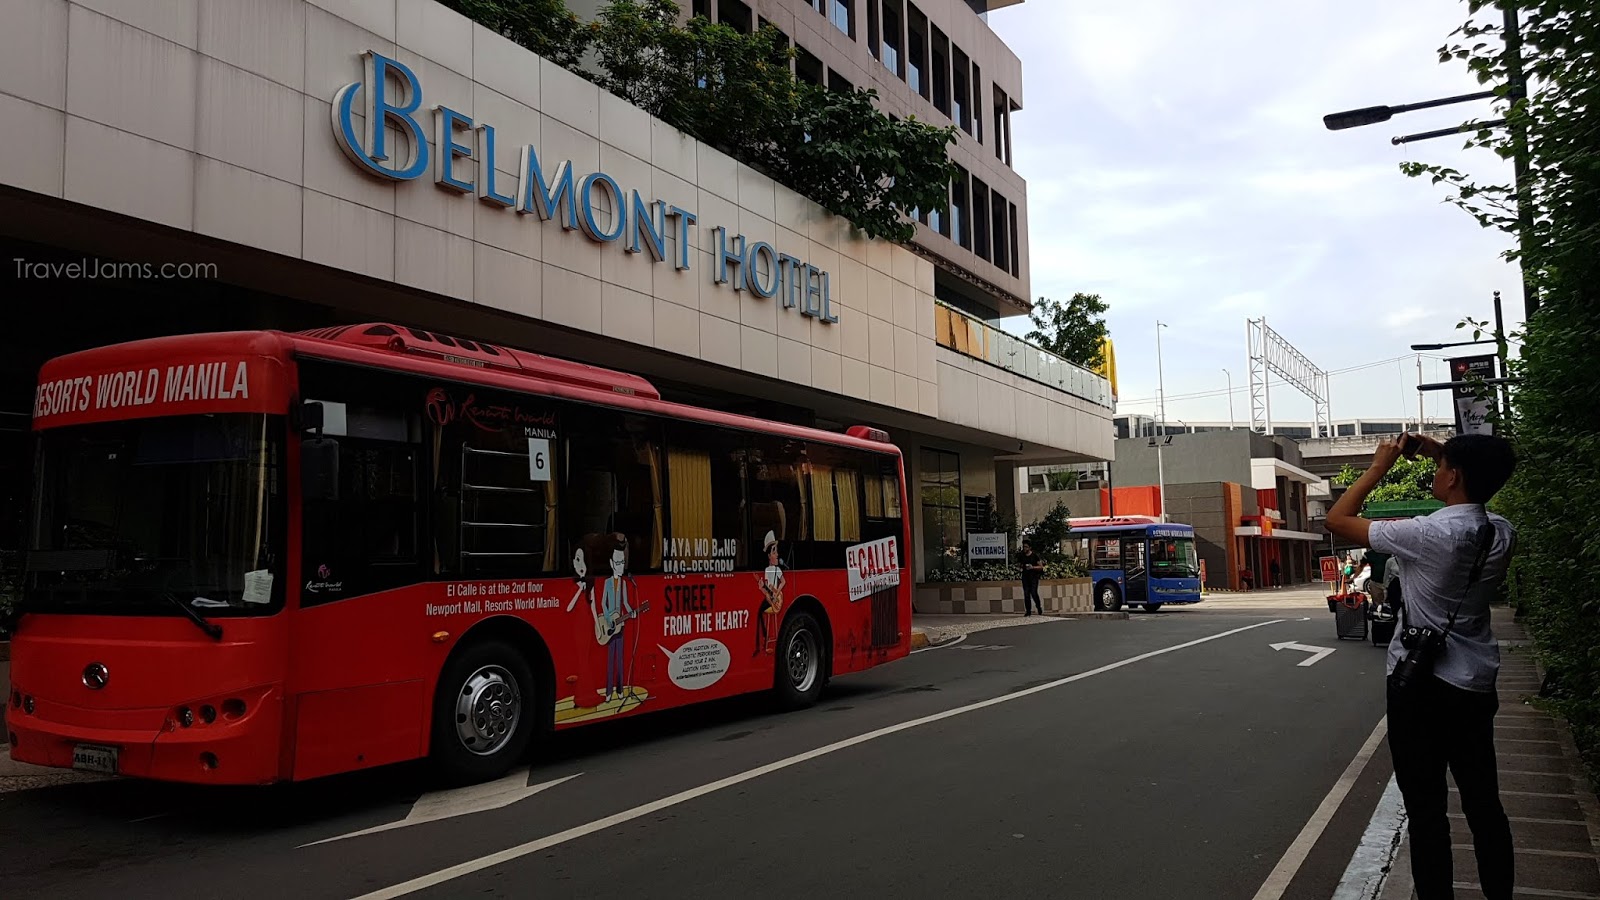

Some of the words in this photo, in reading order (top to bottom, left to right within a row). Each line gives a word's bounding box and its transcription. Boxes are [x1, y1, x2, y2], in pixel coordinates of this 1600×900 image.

[331, 49, 697, 271] BELMONT
[713, 225, 838, 324] HOTEL
[32, 375, 93, 419] RESORTS
[95, 368, 159, 409] WORLD
[163, 361, 249, 402] MANILA
[524, 427, 557, 439] MANILA
[535, 452, 545, 470] 6
[694, 538, 709, 557] MO
[975, 546, 1005, 555] ENTRANCE
[848, 550, 857, 568] EL
[858, 540, 897, 579] CALLE
[447, 584, 455, 597] El
[457, 583, 477, 596] Calle
[479, 583, 486, 595] is
[488, 584, 496, 595] at
[498, 583, 510, 594] the
[512, 582, 526, 594] 2nd
[527, 582, 544, 593] floor
[664, 584, 716, 614] STREET
[426, 602, 461, 617] Newport
[464, 601, 483, 614] Mall,
[485, 600, 513, 612] Resorts
[515, 598, 535, 610] World
[537, 597, 560, 608] Manila
[664, 615, 692, 636] FROM
[695, 613, 713, 633] THE
[715, 609, 750, 631] HEART?
